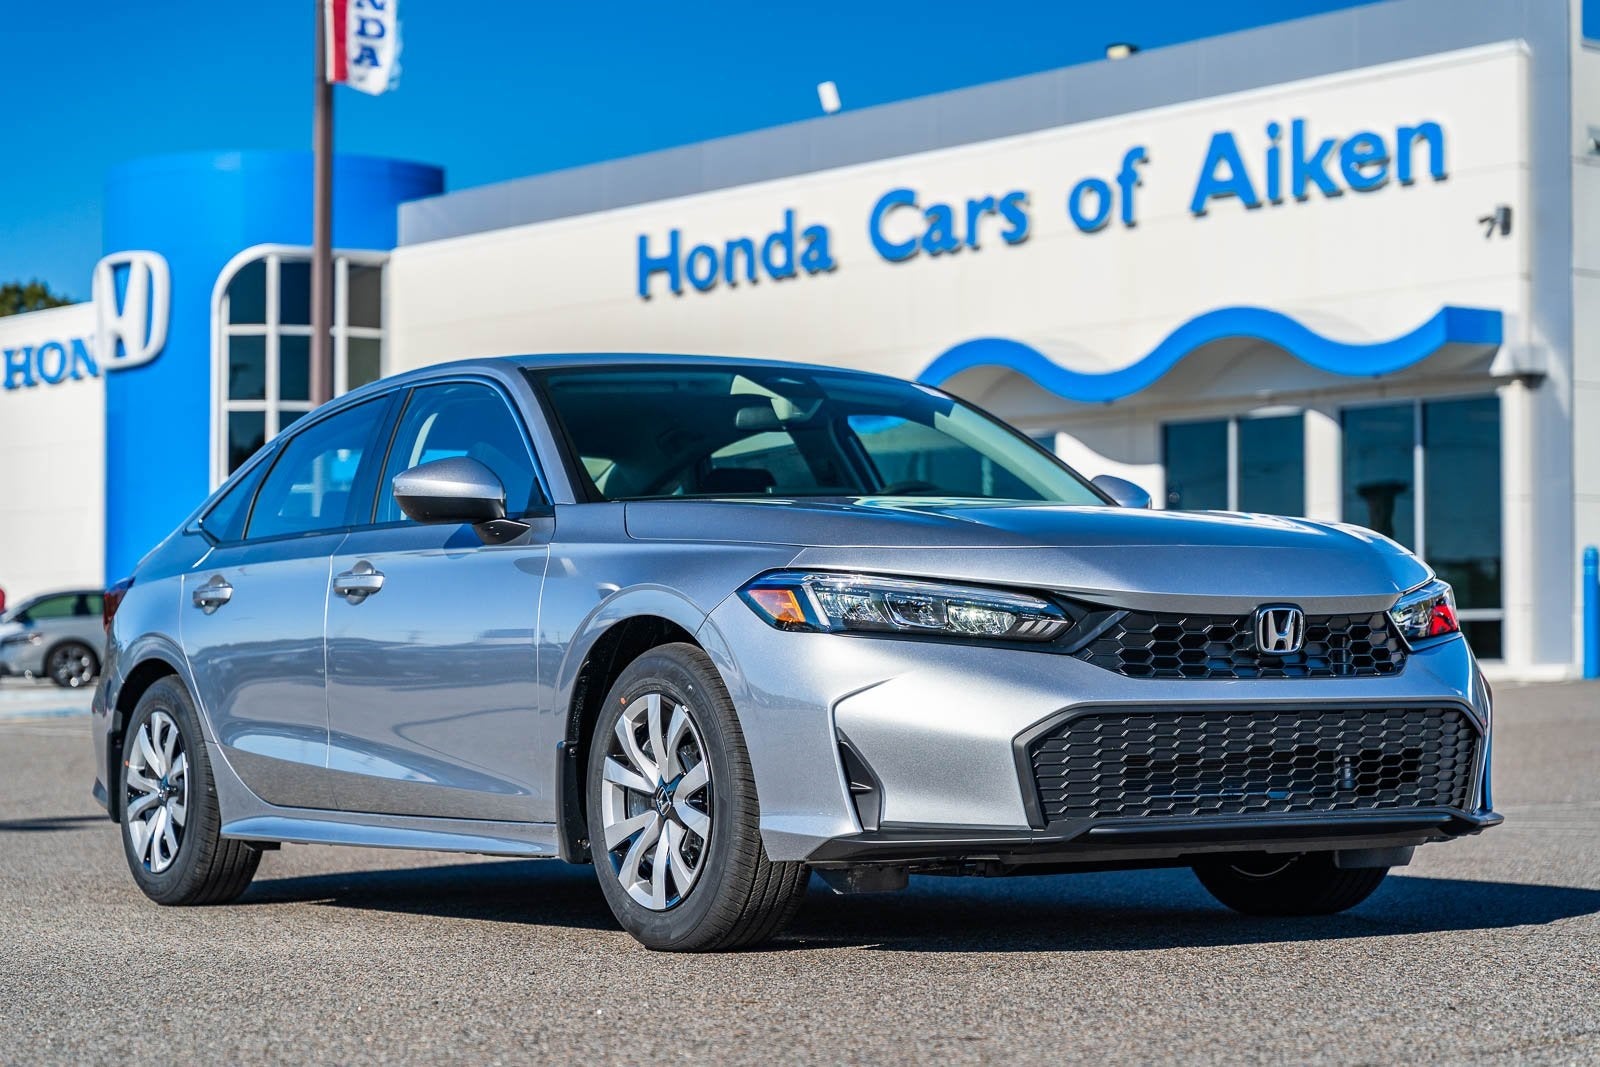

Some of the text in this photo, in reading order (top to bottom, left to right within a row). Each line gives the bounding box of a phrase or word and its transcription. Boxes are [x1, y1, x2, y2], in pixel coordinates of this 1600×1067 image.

[637, 117, 1448, 300] Honda Cars of Aiken
